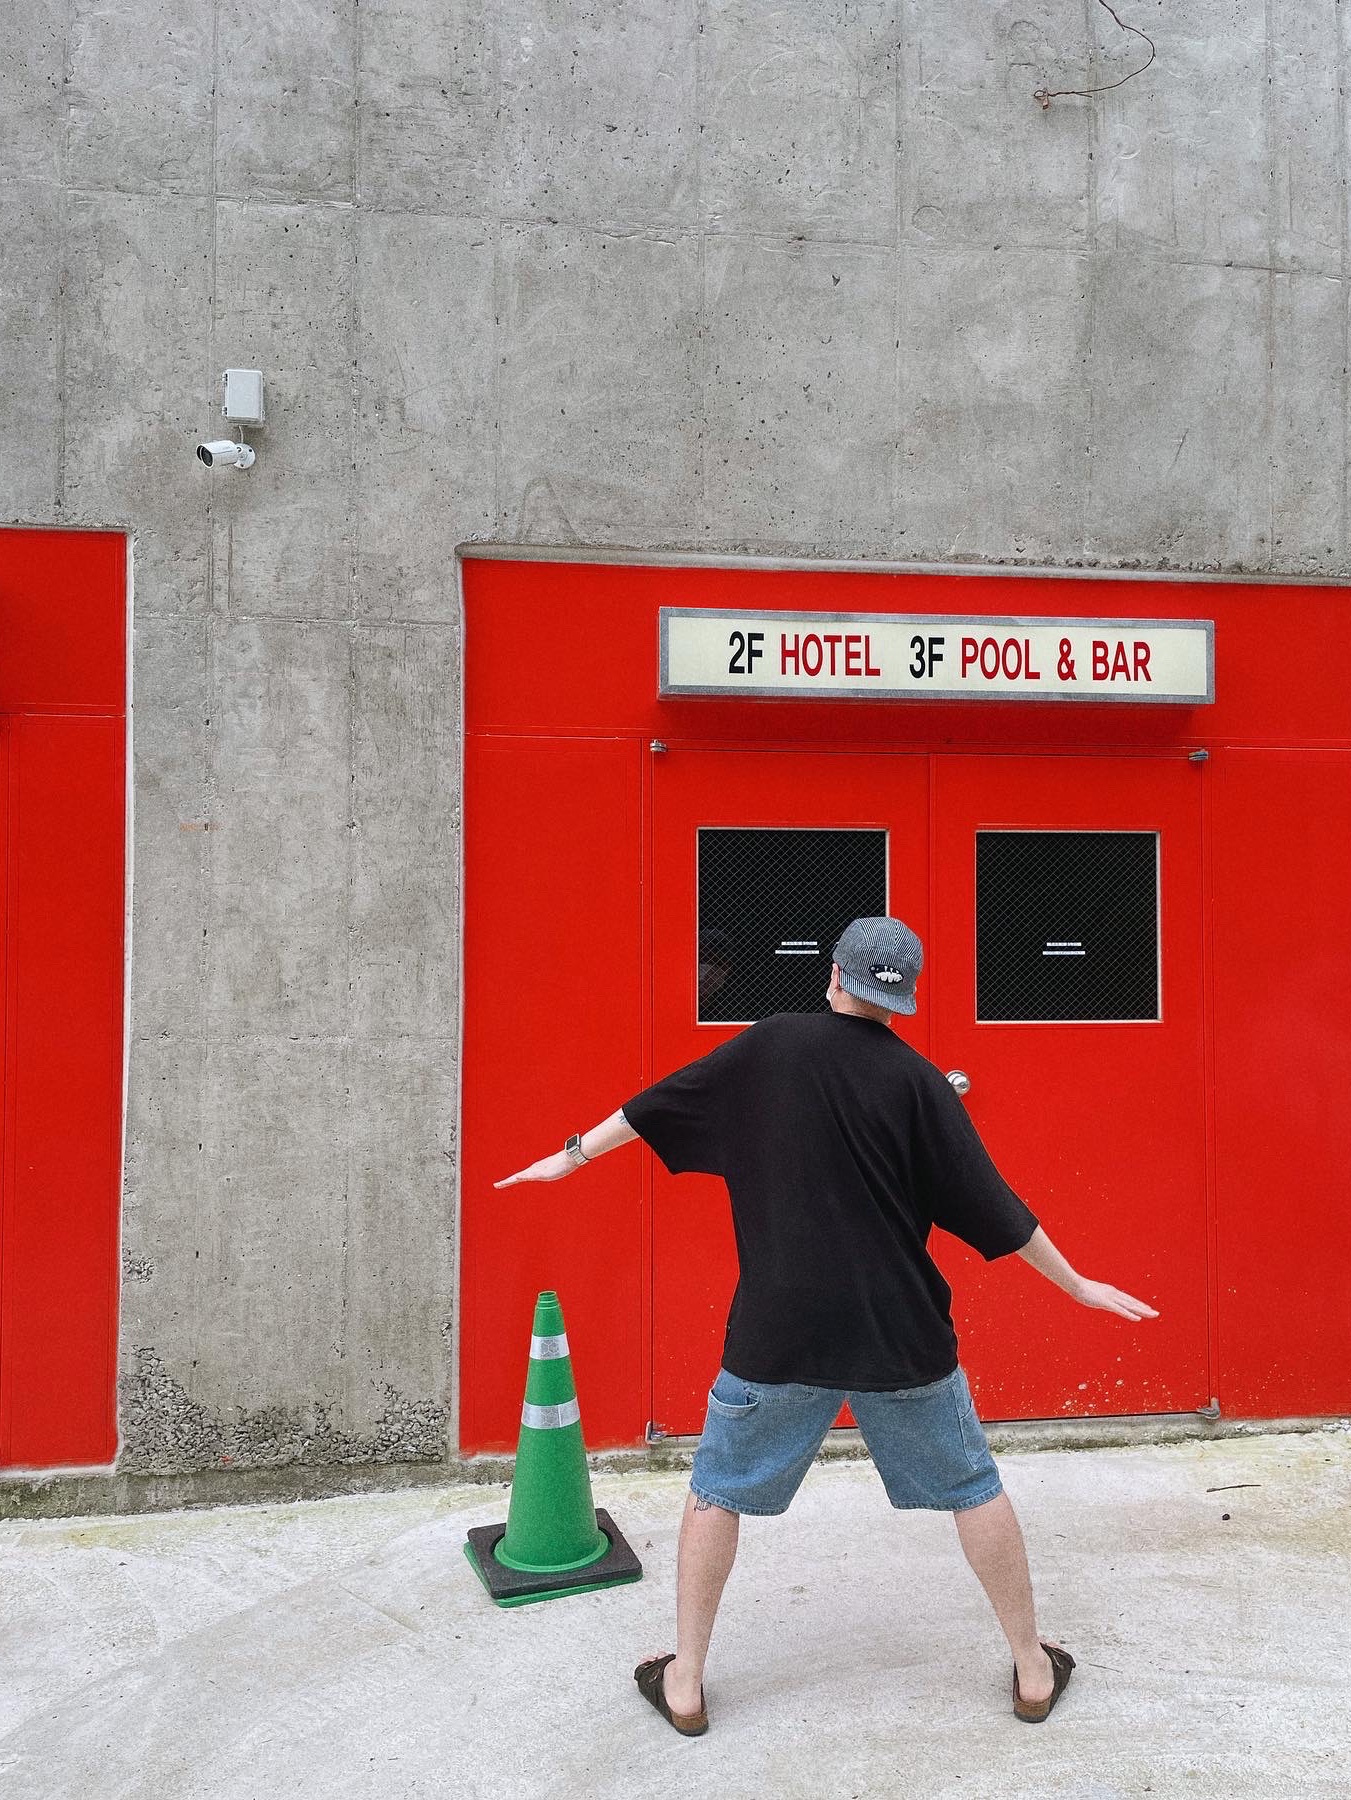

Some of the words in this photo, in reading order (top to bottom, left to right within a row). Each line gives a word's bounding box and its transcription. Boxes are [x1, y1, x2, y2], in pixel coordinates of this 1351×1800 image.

[728, 630, 765, 675] 2F
[780, 633, 881, 677] HOTEL
[909, 635, 945, 679] 3F
[961, 637, 1041, 681] POOL
[1056, 637, 1078, 682] &
[1092, 640, 1153, 682] BAR
